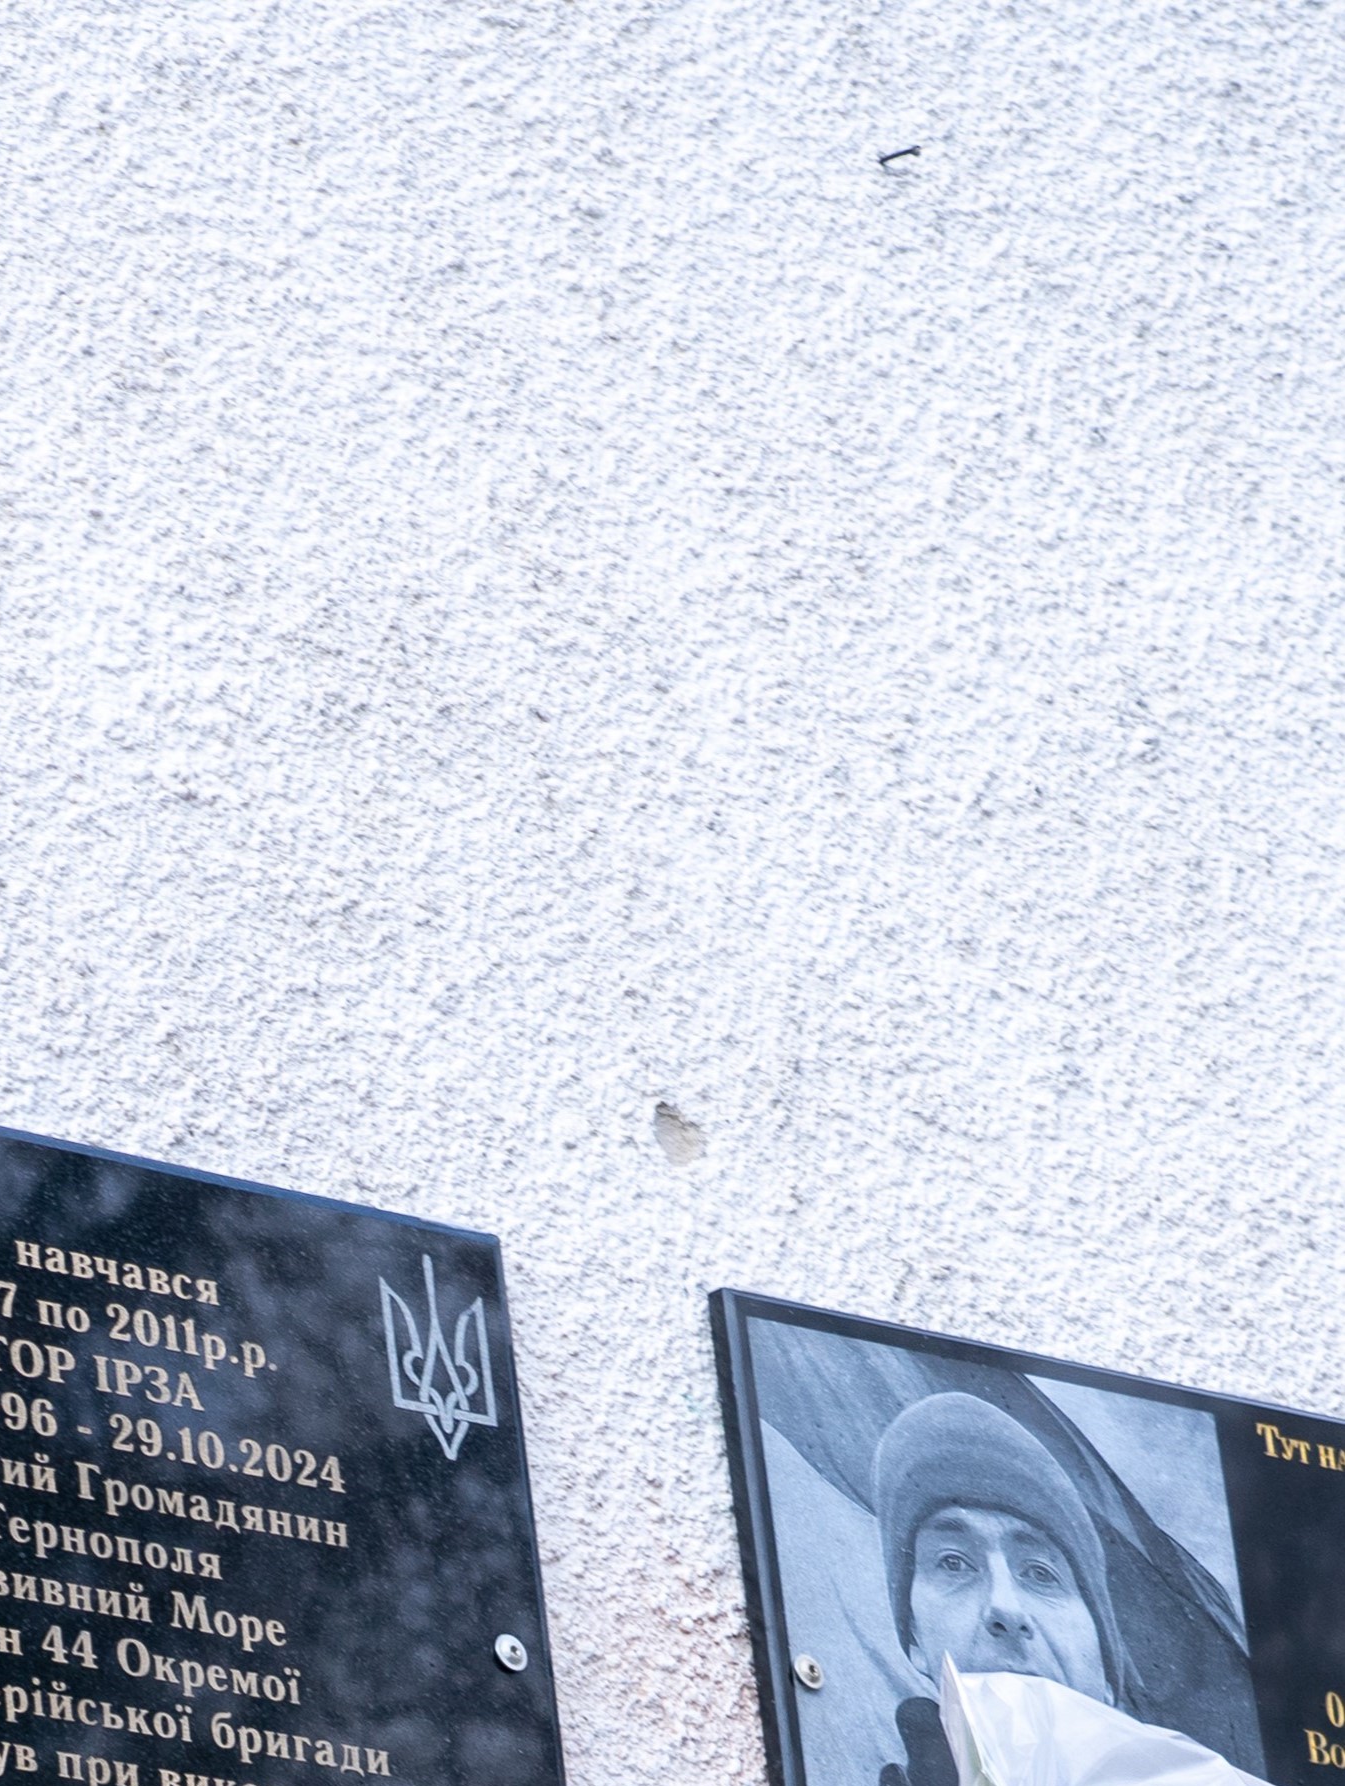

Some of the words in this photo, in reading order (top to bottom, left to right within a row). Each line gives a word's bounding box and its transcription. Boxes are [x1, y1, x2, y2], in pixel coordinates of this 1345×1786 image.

[14, 1240, 220, 1305] навчався
[36, 1299, 90, 1332] по
[93, 1355, 205, 1411] ІРЗА
[109, 1414, 346, 1493] 29.10.2024
[74, 1461, 348, 1547] Громадянин
[170, 1591, 286, 1652] Море
[41, 1625, 98, 1669] 44
[117, 1638, 300, 1704] Окремої
[211, 1712, 391, 1776] бригади
